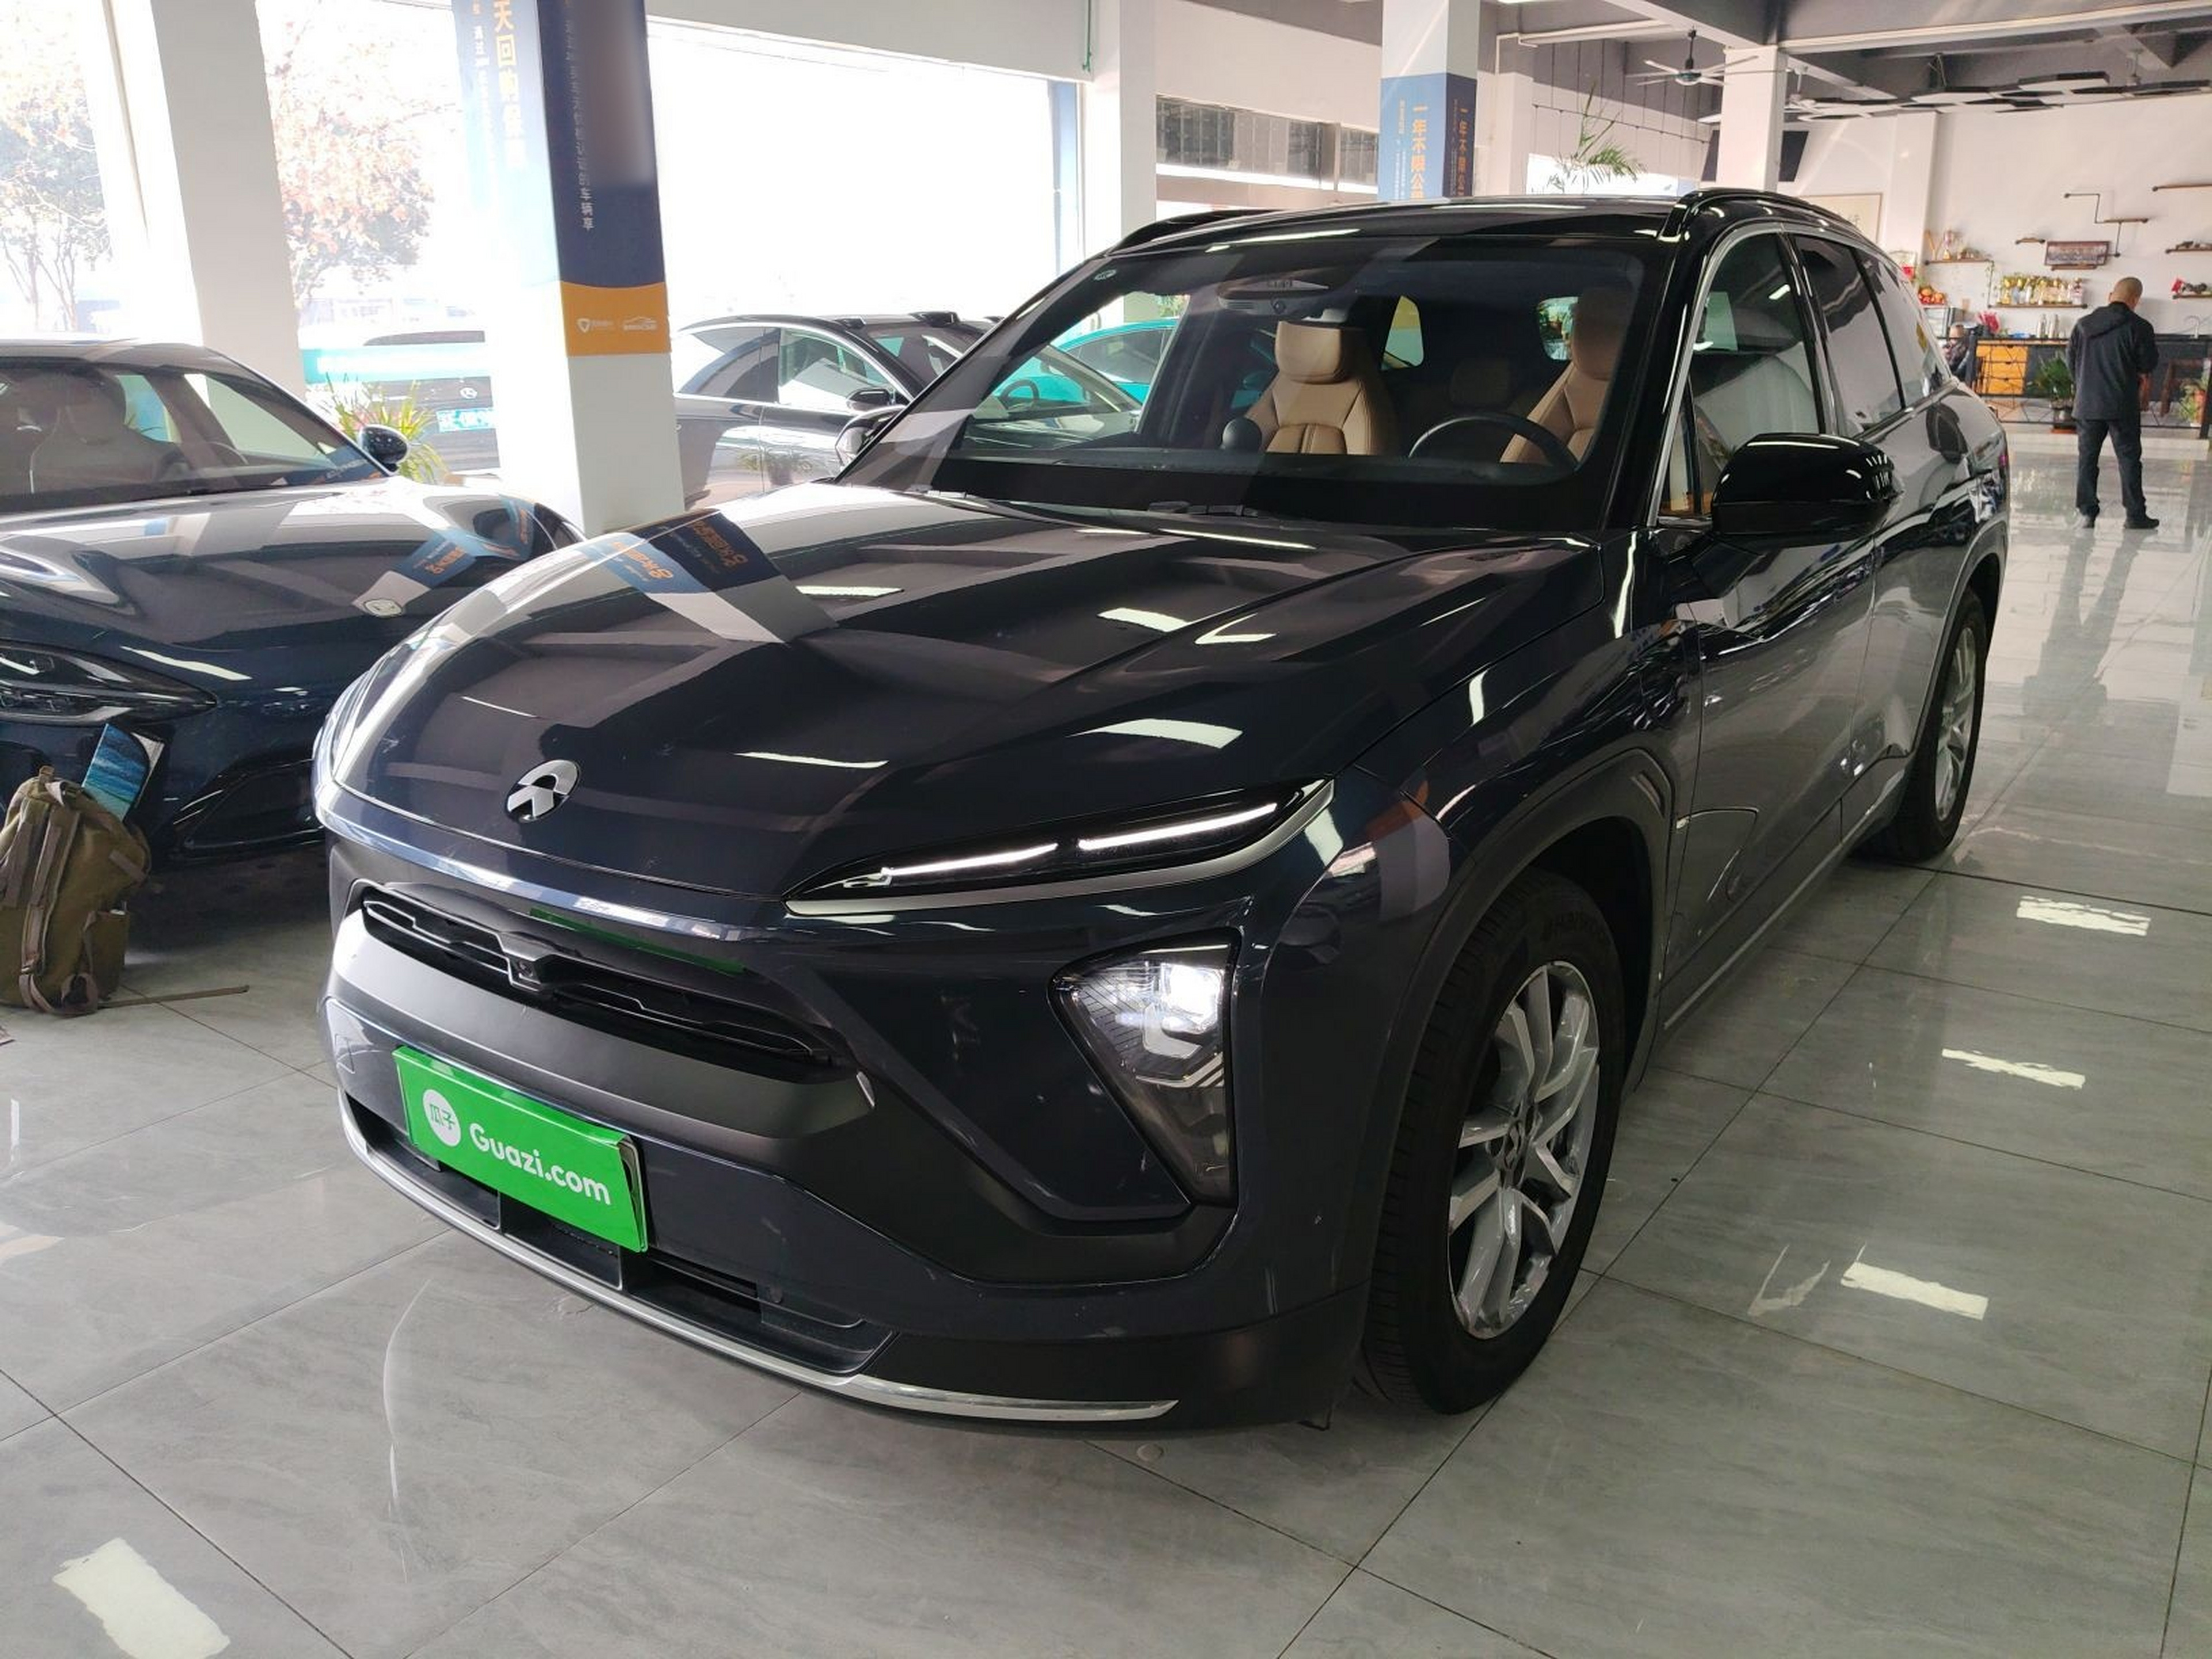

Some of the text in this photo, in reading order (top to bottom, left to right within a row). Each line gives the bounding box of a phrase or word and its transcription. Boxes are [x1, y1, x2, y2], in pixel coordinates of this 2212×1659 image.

[1458, 108, 1468, 196] 一年不限公
[429, 1103, 455, 1131] 瓜子
[469, 1123, 611, 1205] Guazi.com
